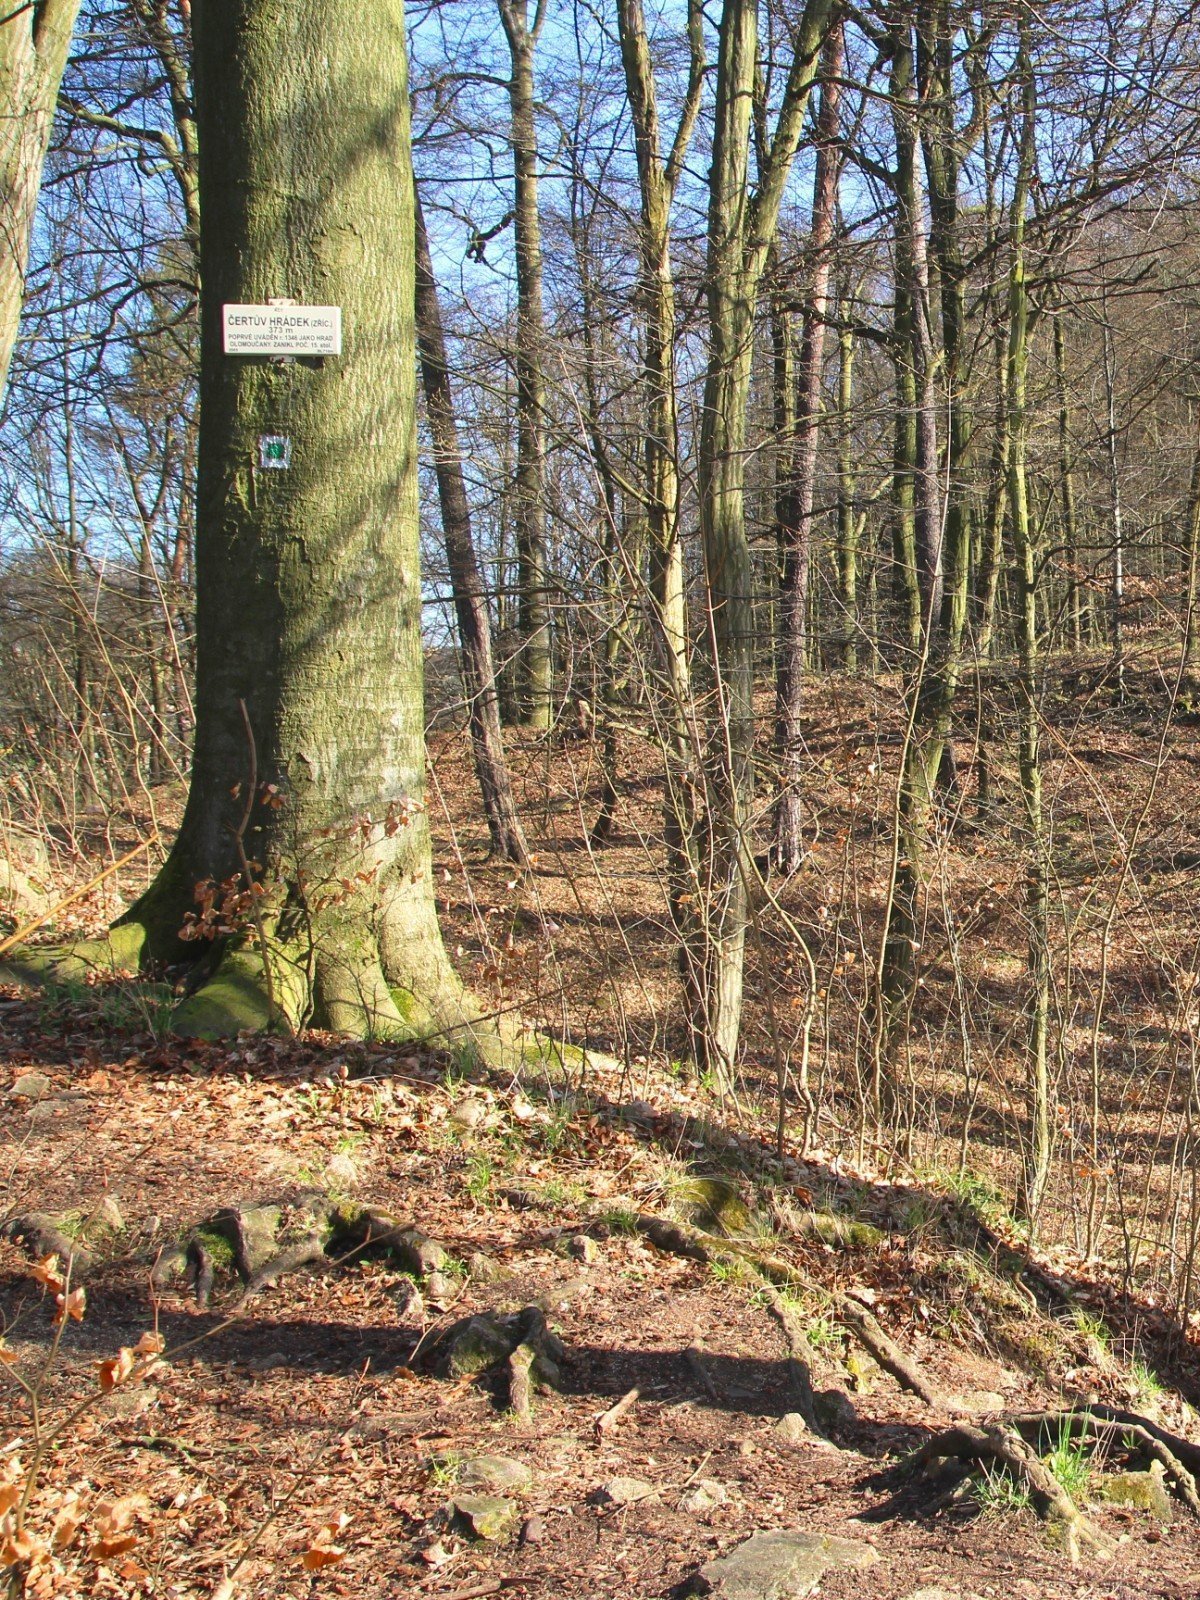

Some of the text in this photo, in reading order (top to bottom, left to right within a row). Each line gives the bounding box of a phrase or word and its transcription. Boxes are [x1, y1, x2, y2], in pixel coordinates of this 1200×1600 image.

[228, 314, 266, 326] ČERTŮV
[269, 316, 309, 327] HRÁDEK
[268, 326, 283, 334] 373
[228, 333, 253, 341] POPRVÉ
